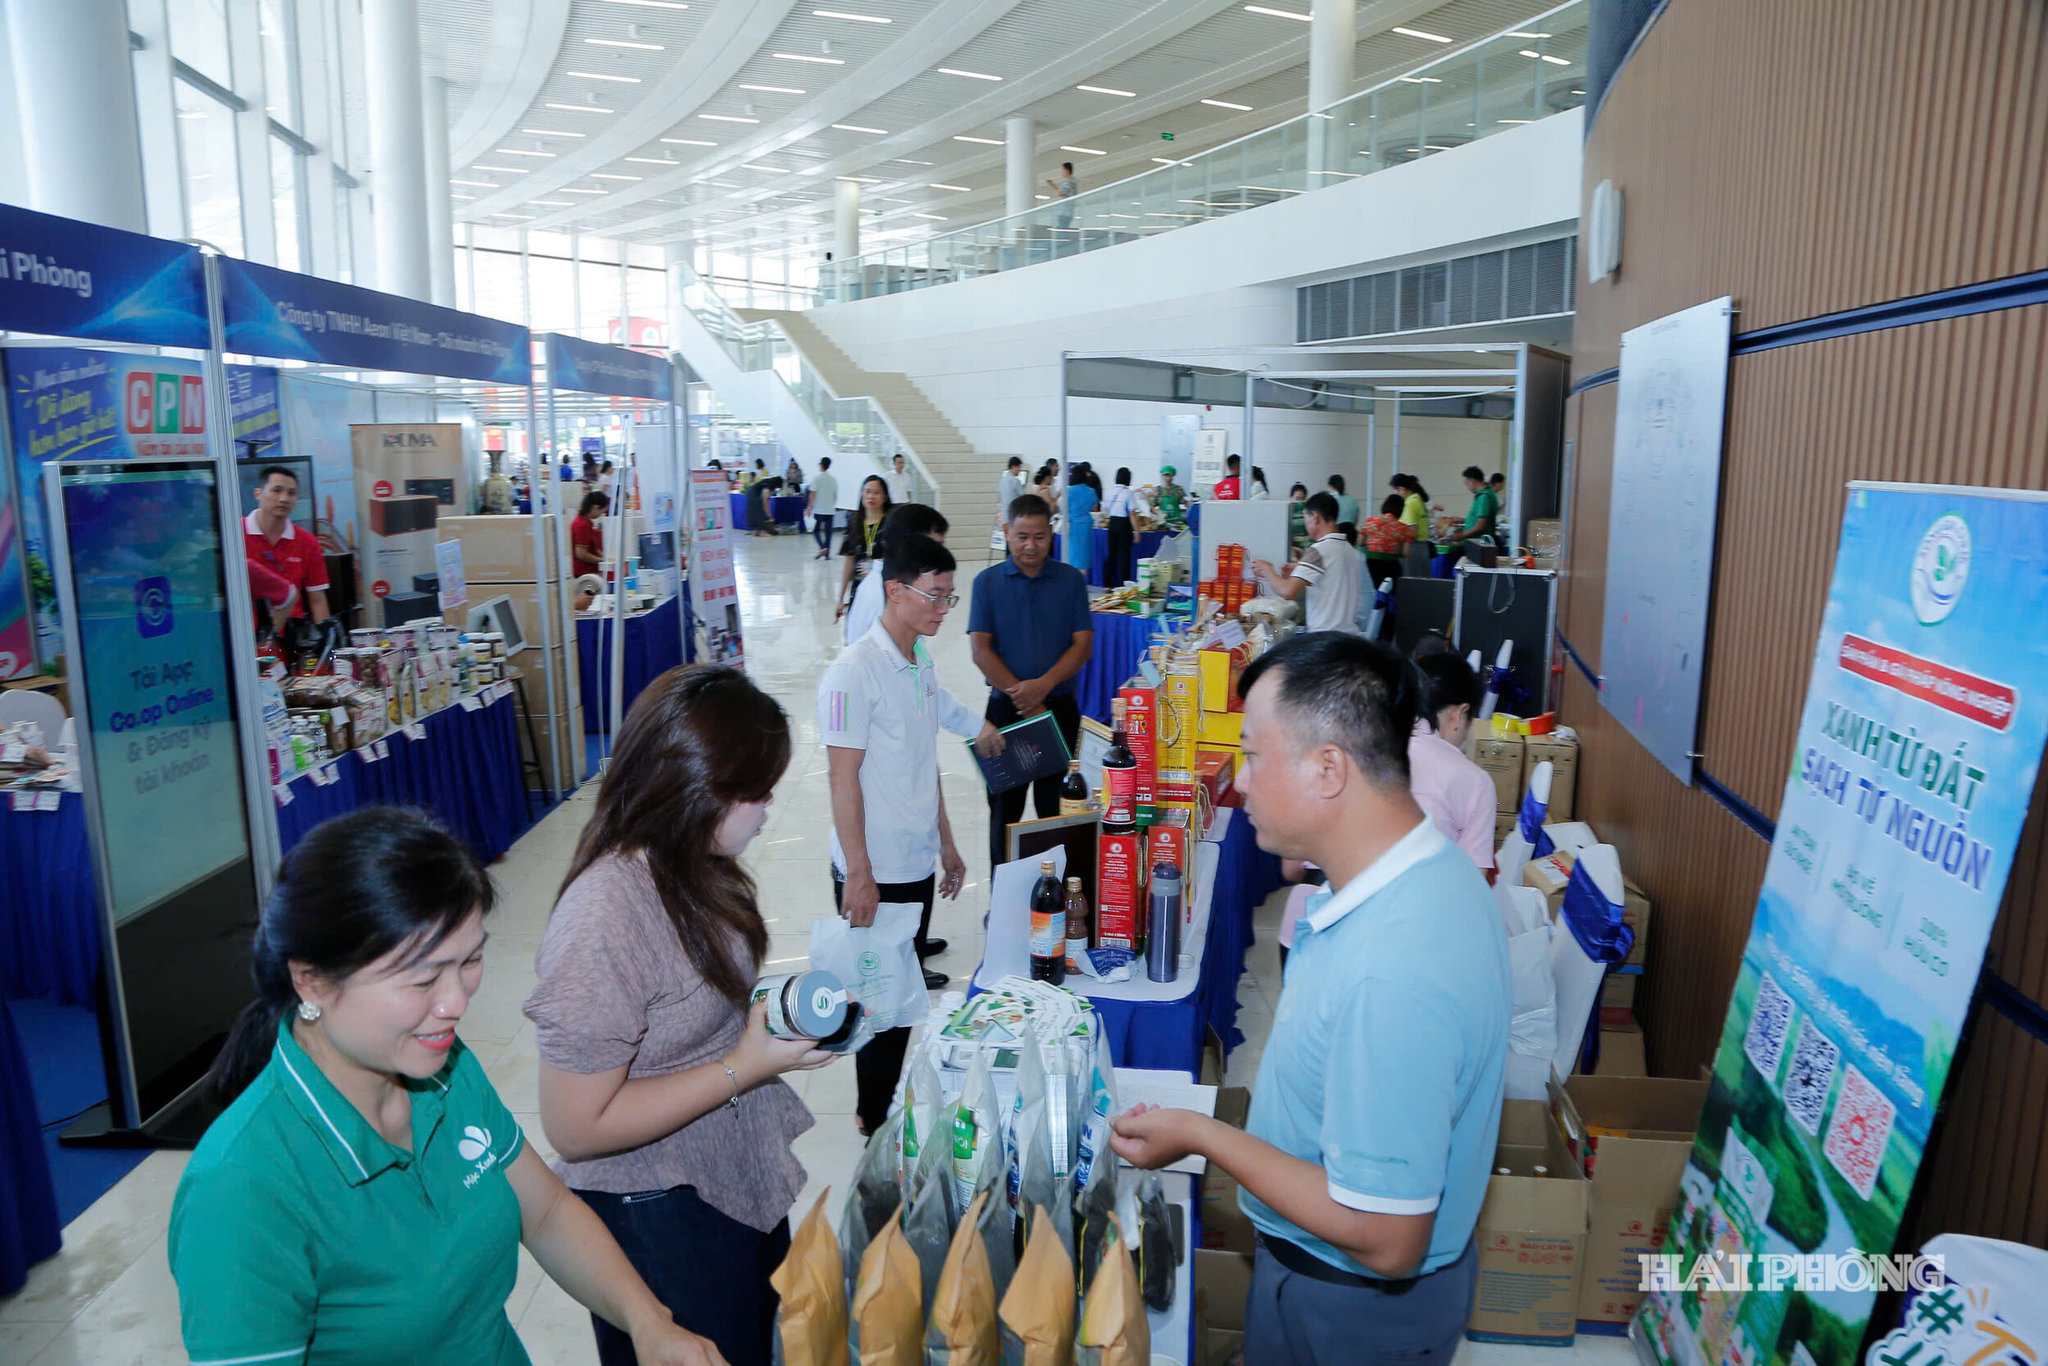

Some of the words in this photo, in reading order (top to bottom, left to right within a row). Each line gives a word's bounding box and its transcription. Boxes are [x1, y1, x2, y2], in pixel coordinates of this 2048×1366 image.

[12, 251, 92, 297] Phòng
[276, 301, 312, 332] Công
[314, 310, 326, 333] ty
[327, 311, 361, 335] TNHH
[129, 376, 204, 431] CPN
[130, 665, 158, 691] Tải
[161, 660, 194, 686] App
[110, 704, 162, 731] Co.op
[166, 687, 215, 715] Online
[1821, 700, 1884, 763] XANH
[1882, 726, 1924, 780] TỪ
[1917, 740, 1988, 811] ĐẤT
[1801, 747, 1852, 806] SẠCH
[1884, 811, 1994, 892] NGUỒN
